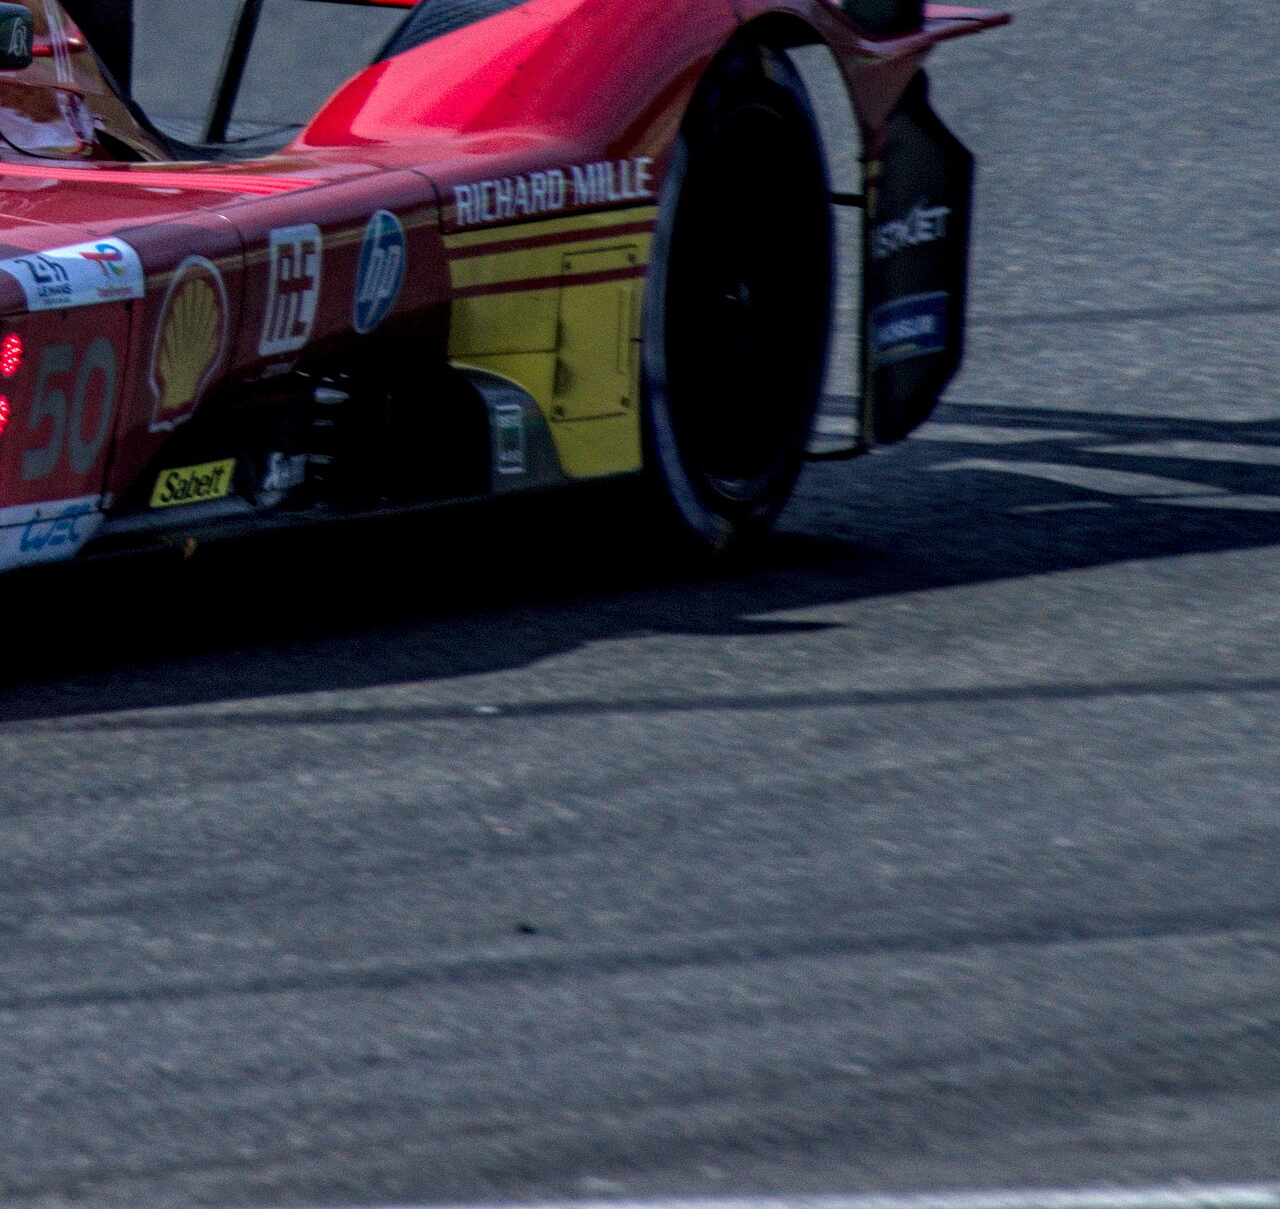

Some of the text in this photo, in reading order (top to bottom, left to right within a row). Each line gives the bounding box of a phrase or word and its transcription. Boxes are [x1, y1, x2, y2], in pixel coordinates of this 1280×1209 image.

[453, 157, 654, 226] RICHARD MILLE
[357, 218, 403, 328] hp
[19, 336, 117, 481] 50
[160, 466, 225, 503] Sabelt
